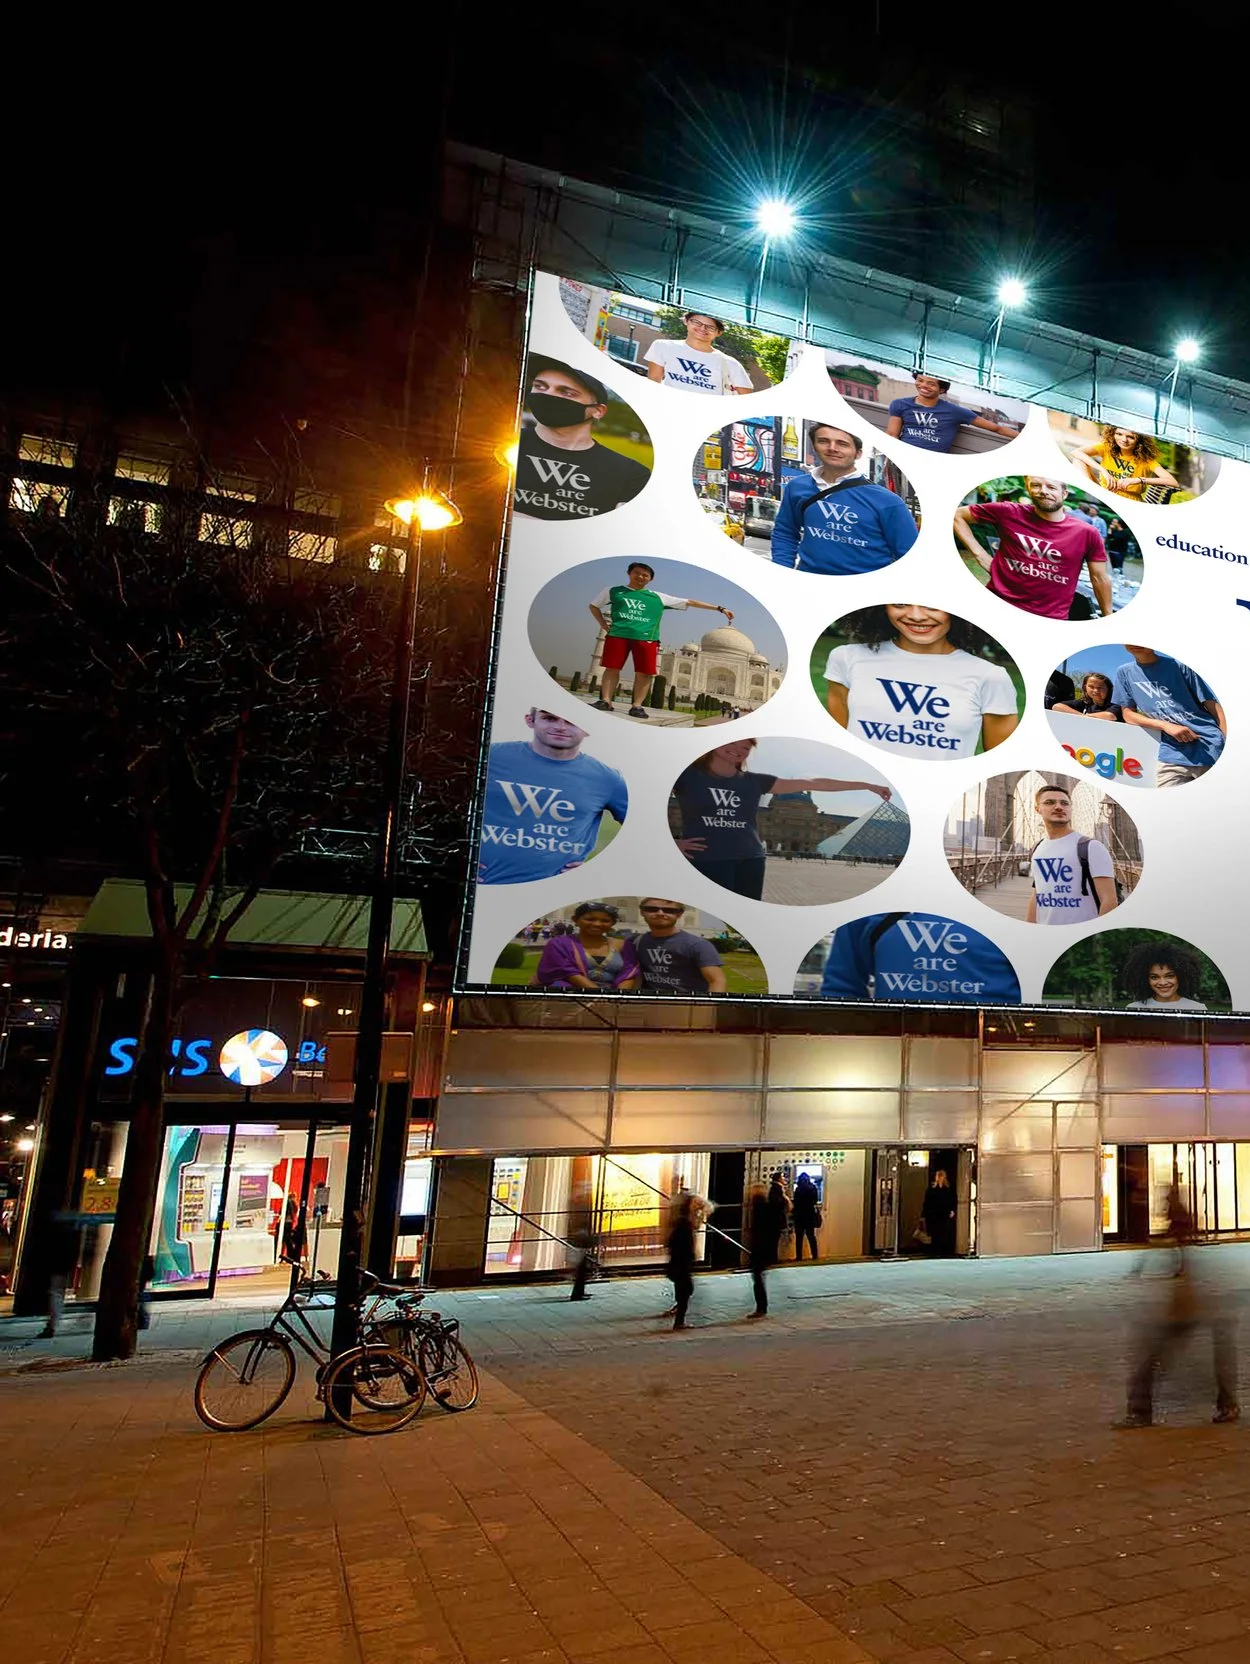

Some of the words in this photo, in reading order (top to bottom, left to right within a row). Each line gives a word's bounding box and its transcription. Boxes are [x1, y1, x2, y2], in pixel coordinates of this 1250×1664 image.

[676, 357, 712, 377] We
[667, 371, 717, 390] Webster
[912, 410, 938, 428] We
[907, 428, 940, 443] Webster
[526, 454, 591, 490] We
[1112, 456, 1135, 474] We
[514, 488, 599, 516] Webster
[556, 488, 585, 501] are
[816, 499, 859, 524] We
[826, 521, 852, 533] are
[807, 526, 868, 547] Webster
[1014, 532, 1062, 563] We
[1155, 533, 1249, 565] education
[1004, 557, 1069, 585] Webster
[1038, 561, 1059, 572] are
[622, 597, 646, 610] We
[618, 612, 651, 622] Webster
[876, 678, 950, 718] We
[1133, 681, 1172, 699] We
[1154, 700, 1175, 709] are
[912, 719, 945, 732] are
[857, 720, 960, 750] Webster
[495, 780, 575, 822] We
[708, 787, 741, 808] We
[716, 808, 736, 816] are
[533, 823, 568, 836] are
[701, 815, 747, 828] Webster
[481, 824, 586, 854] Webster
[1034, 857, 1073, 882] We
[1054, 885, 1072, 893] are
[896, 919, 967, 954] We
[647, 948, 672, 964] We
[913, 956, 957, 971] are
[643, 972, 681, 985] Webster
[879, 972, 984, 994] Webster
[105, 1037, 212, 1076] SS
